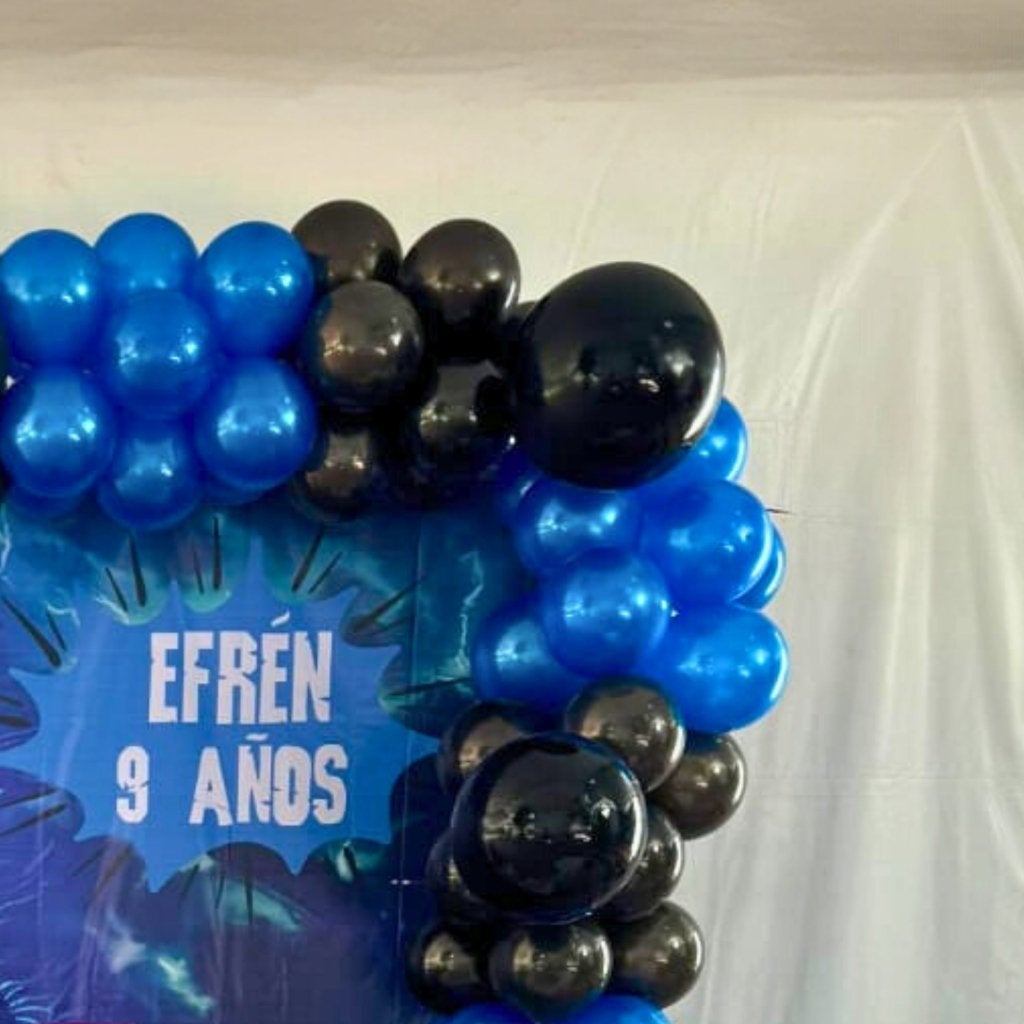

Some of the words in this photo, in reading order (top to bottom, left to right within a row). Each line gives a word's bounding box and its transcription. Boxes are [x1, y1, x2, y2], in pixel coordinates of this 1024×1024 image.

[148, 610, 333, 725] EFRÉN
[116, 745, 150, 823] 9
[189, 733, 348, 826] AÑOS
